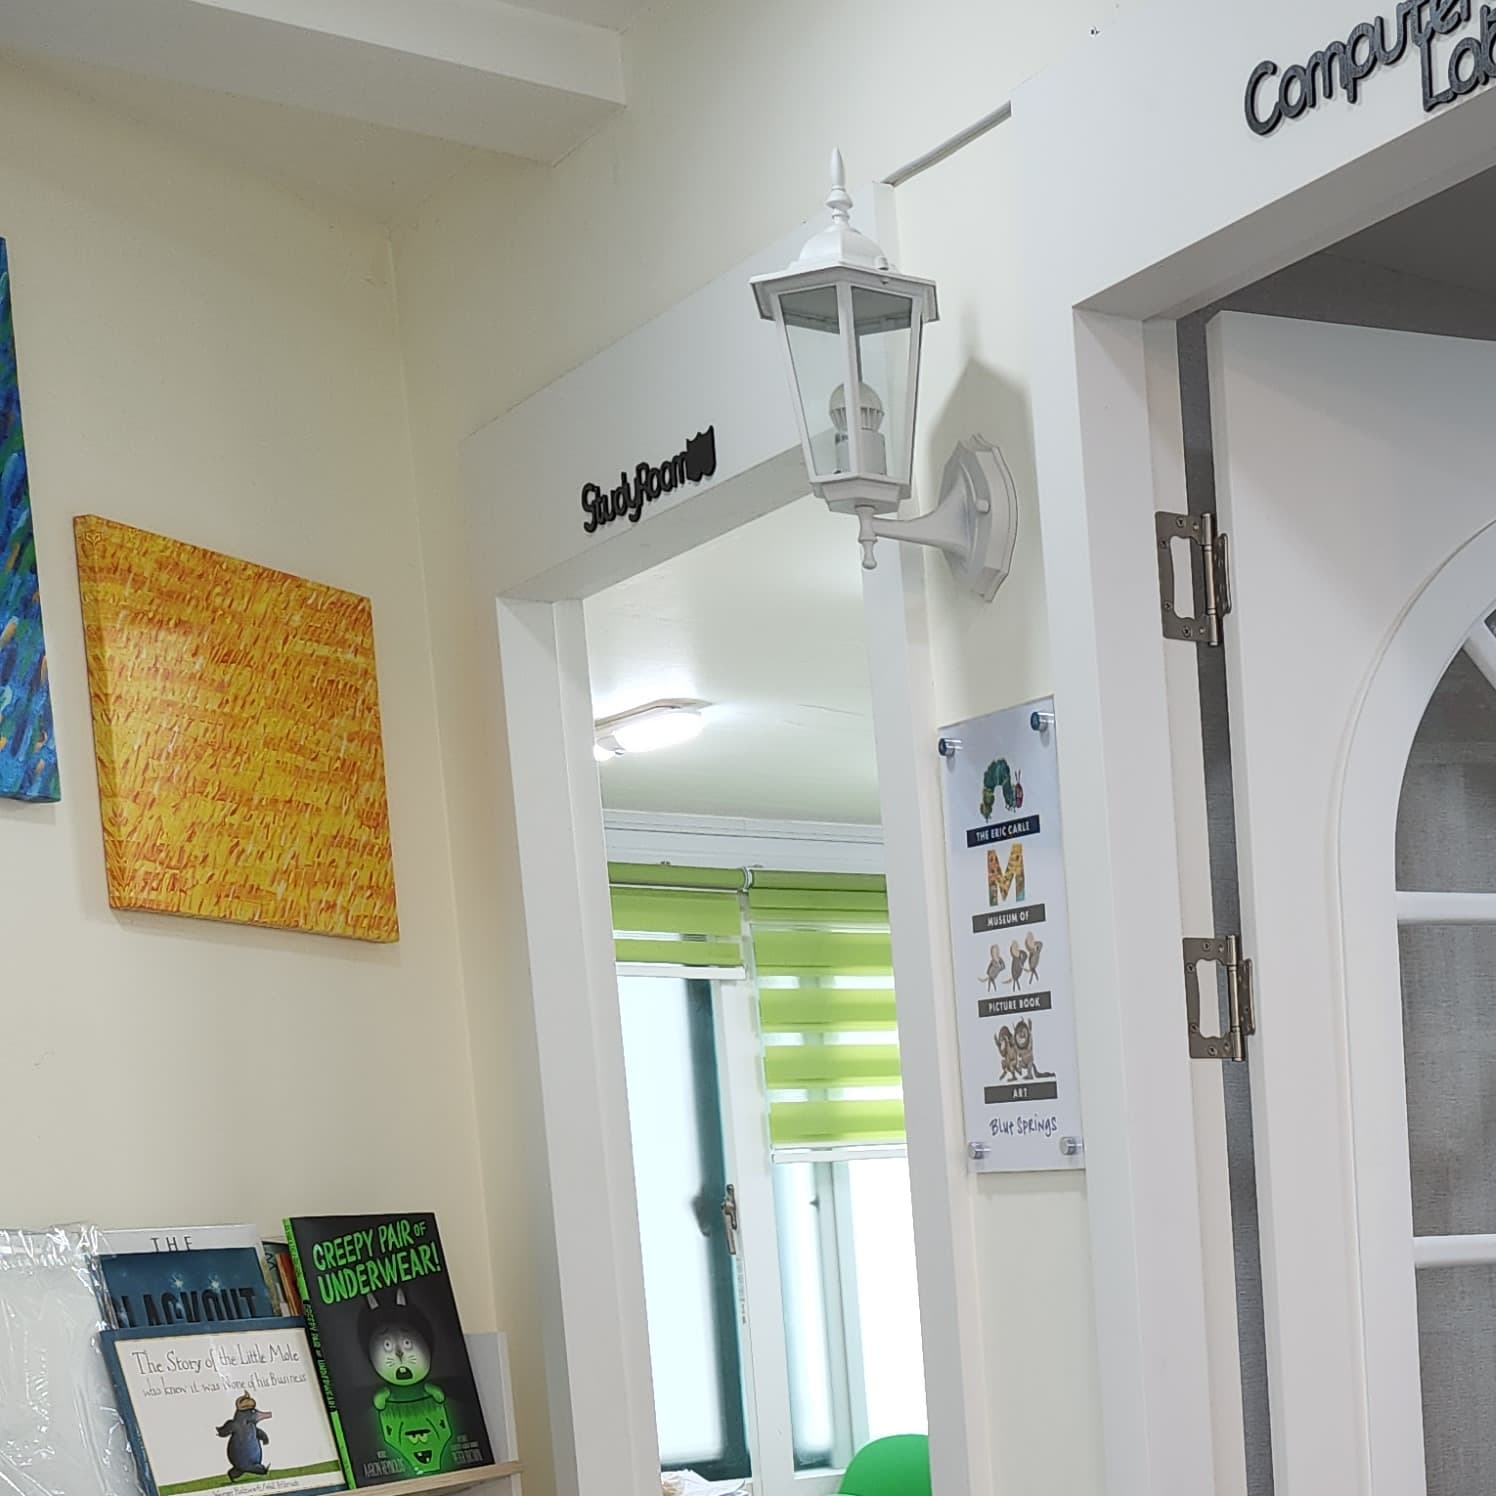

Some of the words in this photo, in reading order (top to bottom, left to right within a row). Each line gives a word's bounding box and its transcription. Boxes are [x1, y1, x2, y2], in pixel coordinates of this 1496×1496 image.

[976, 829, 990, 842] THE
[991, 825, 1006, 840] ERIC
[1007, 820, 1030, 837] CARLE
[987, 912, 1018, 926] MUSEUM
[1019, 910, 1029, 923] OF
[988, 999, 1017, 1012] PICTURE
[1019, 996, 1041, 1010] BOOK
[1013, 1087, 1028, 1099] ART
[312, 1228, 374, 1272] CREEPY
[378, 1218, 414, 1254] PAIR
[413, 1220, 428, 1238] OF
[316, 1241, 443, 1306] UNDERWEAR!
[132, 1349, 162, 1375] The
[166, 1349, 201, 1373] Story
[205, 1346, 218, 1373] of
[219, 1345, 239, 1366] the
[240, 1344, 267, 1365] Little
[269, 1343, 300, 1363] Mole
